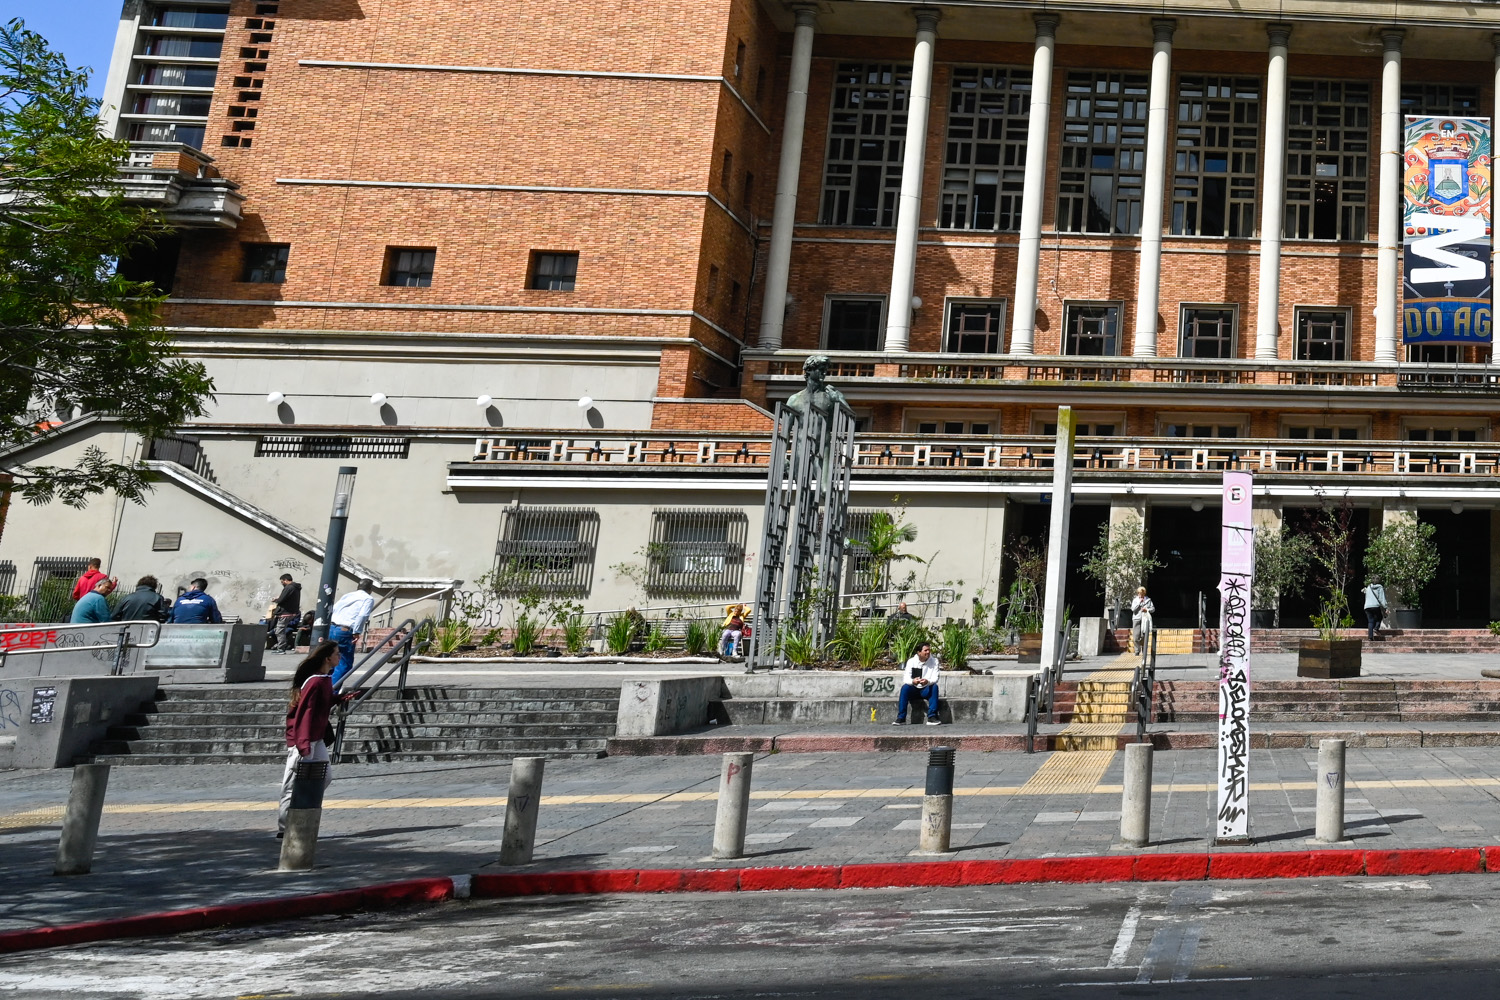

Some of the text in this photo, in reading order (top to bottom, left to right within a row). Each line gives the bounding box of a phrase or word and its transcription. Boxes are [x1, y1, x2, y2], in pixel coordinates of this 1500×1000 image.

[1441, 129, 1454, 138] EN
[1404, 306, 1491, 338] DO AG
